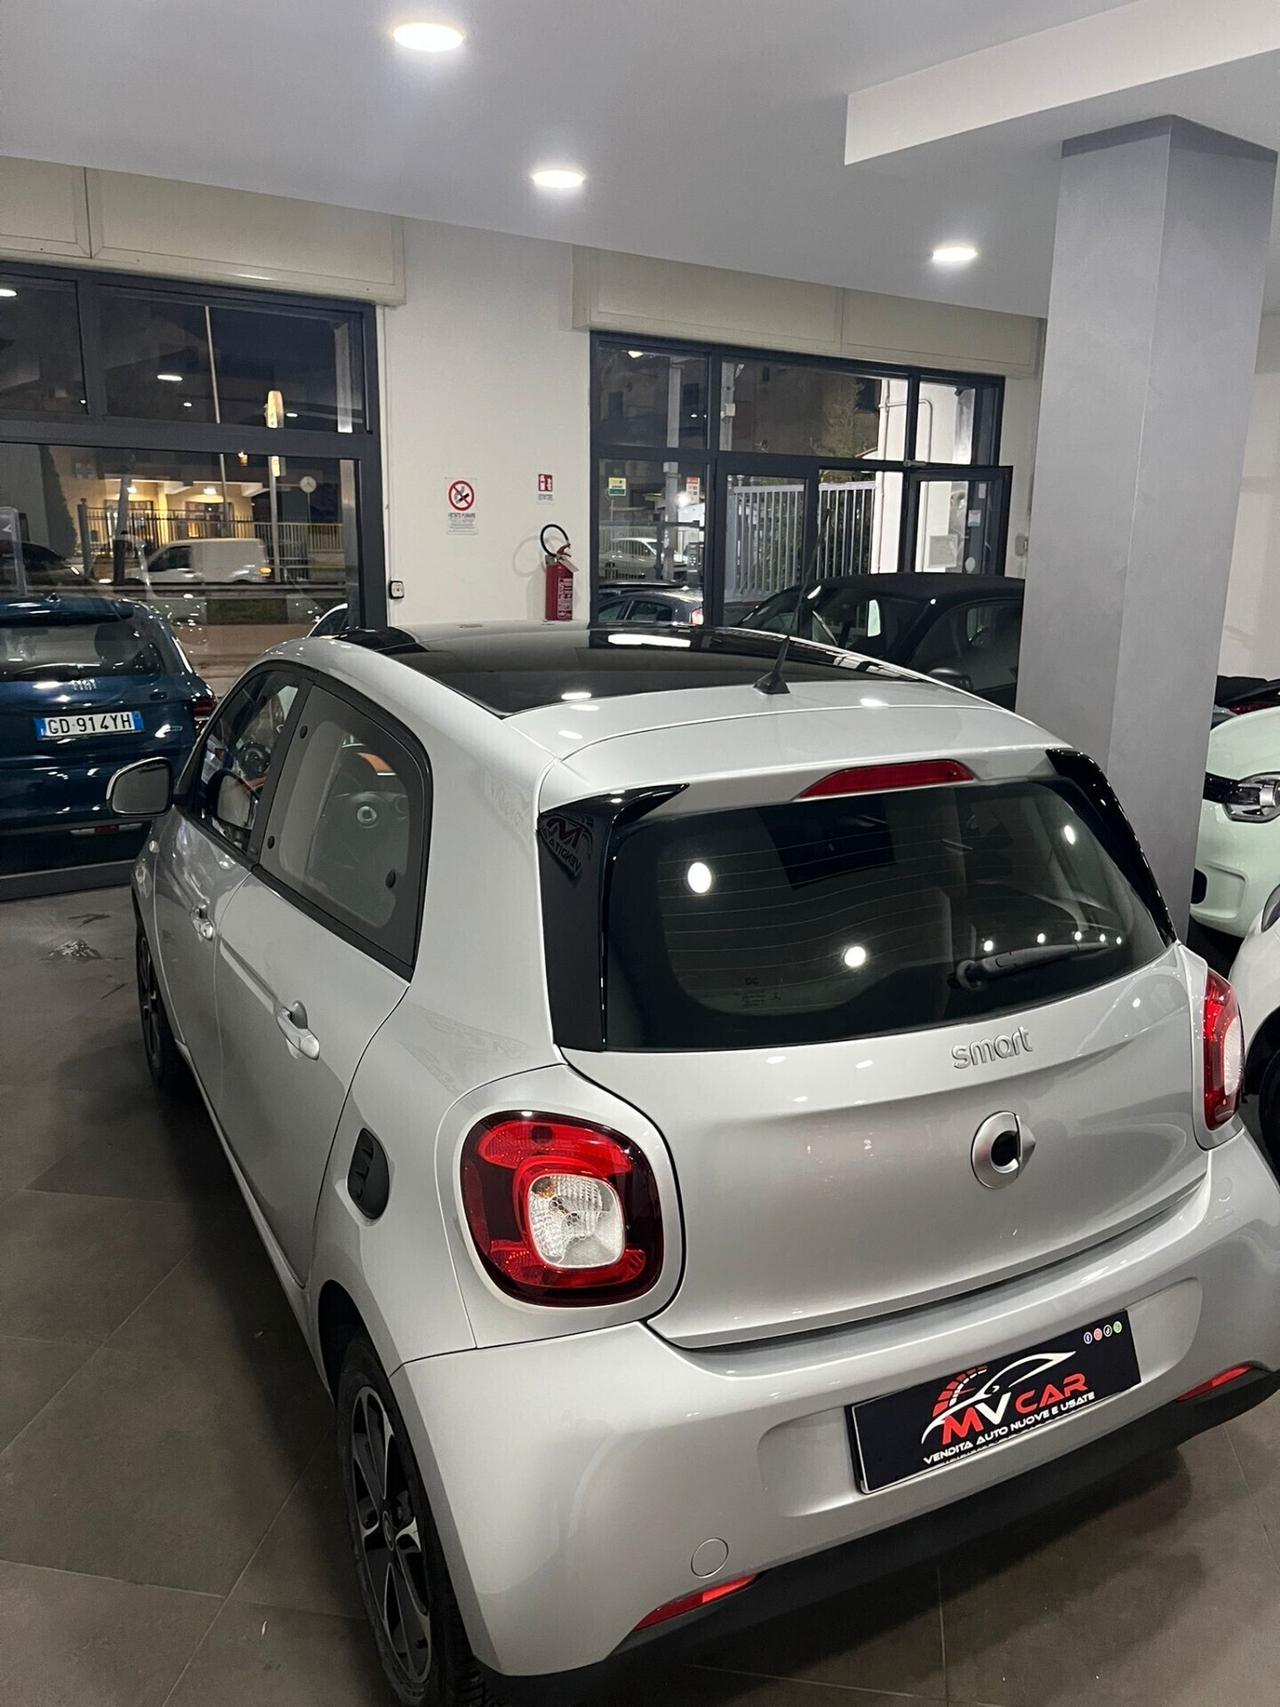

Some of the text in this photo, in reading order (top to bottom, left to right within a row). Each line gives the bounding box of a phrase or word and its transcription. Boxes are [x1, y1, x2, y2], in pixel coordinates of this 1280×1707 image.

[951, 1026, 1033, 1070] smart
[923, 1440, 973, 1465] VENDITA
[976, 1427, 1008, 1445] AUTO
[1010, 1408, 1050, 1432] NUOVE
[1051, 1405, 1059, 1415] E
[1060, 1391, 1096, 1412] USATE
